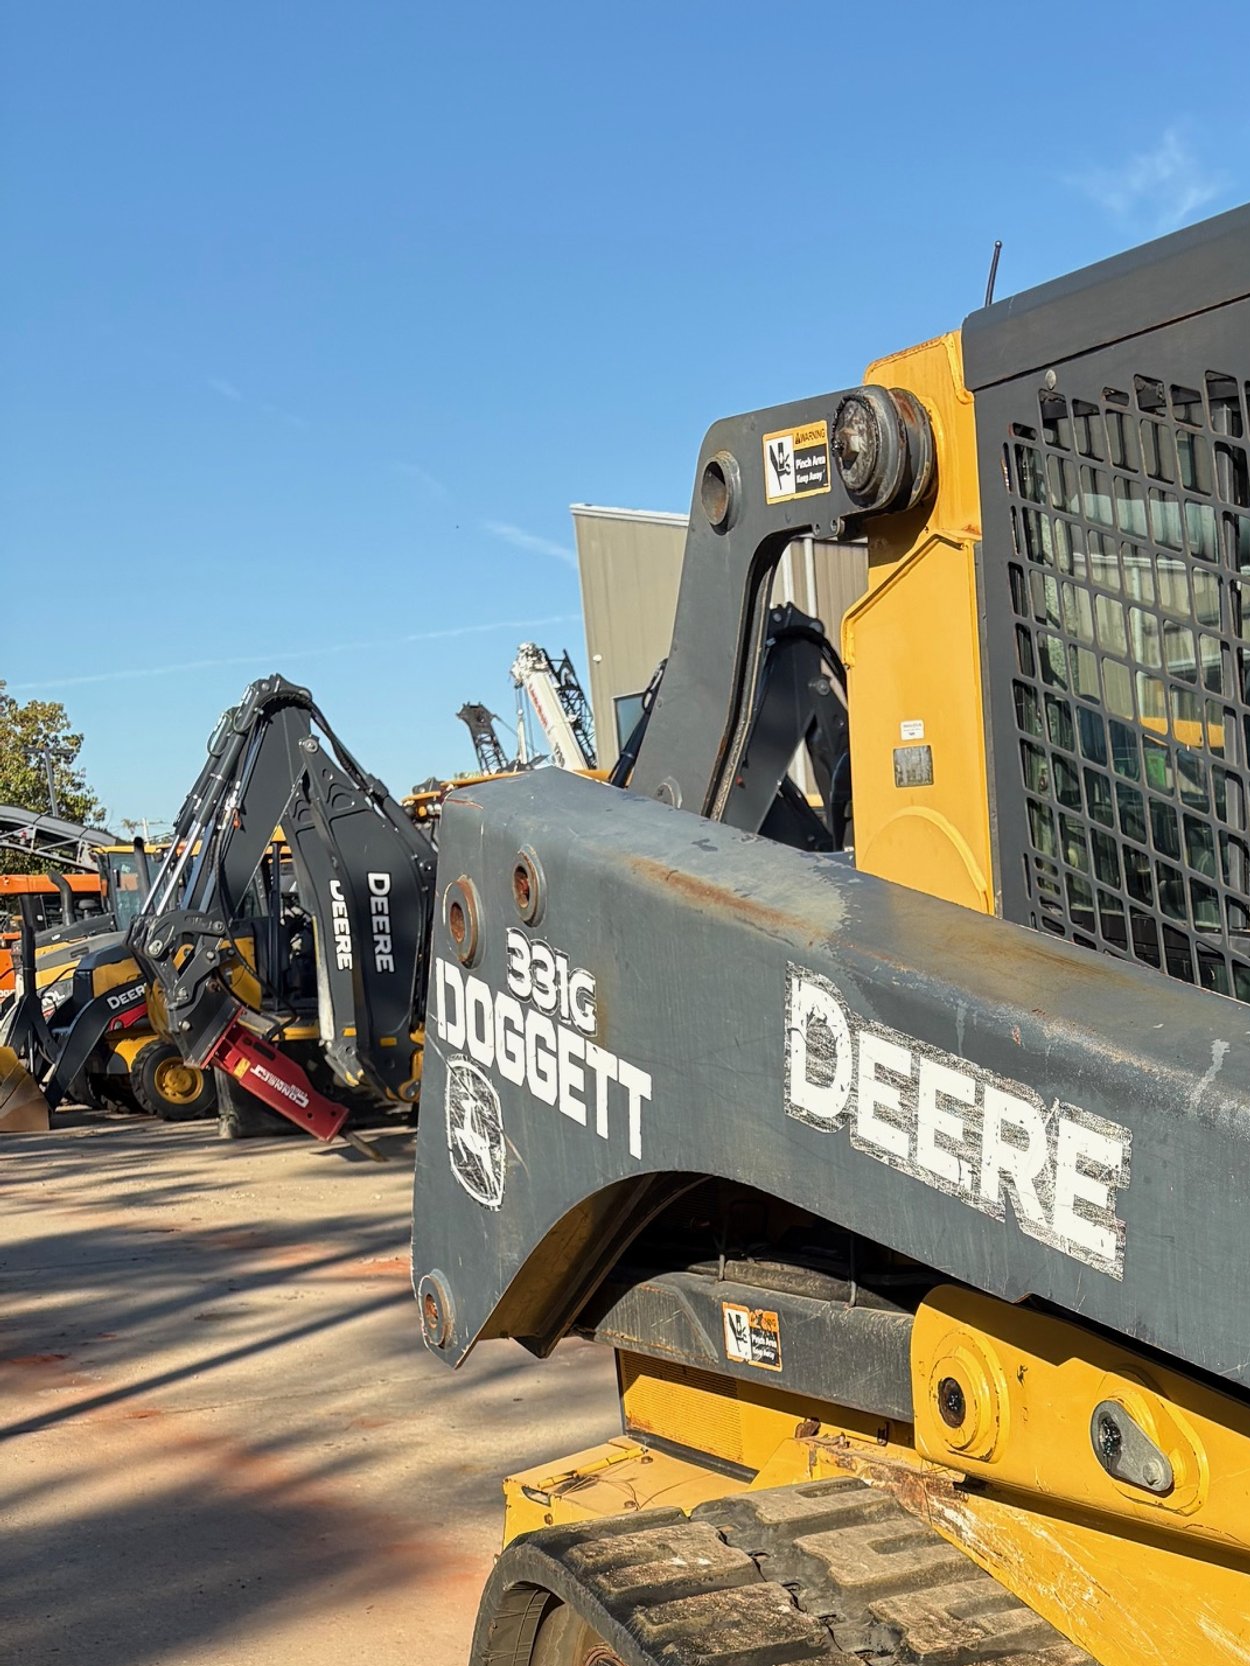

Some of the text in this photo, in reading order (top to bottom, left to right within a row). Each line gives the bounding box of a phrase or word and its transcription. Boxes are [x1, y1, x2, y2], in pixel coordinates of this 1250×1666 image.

[367, 872, 395, 973] DEERE
[107, 982, 147, 1010] DEER
[505, 927, 598, 1037] 331G
[436, 957, 652, 1161] DOGGETT
[787, 966, 1128, 1272] DEERE
